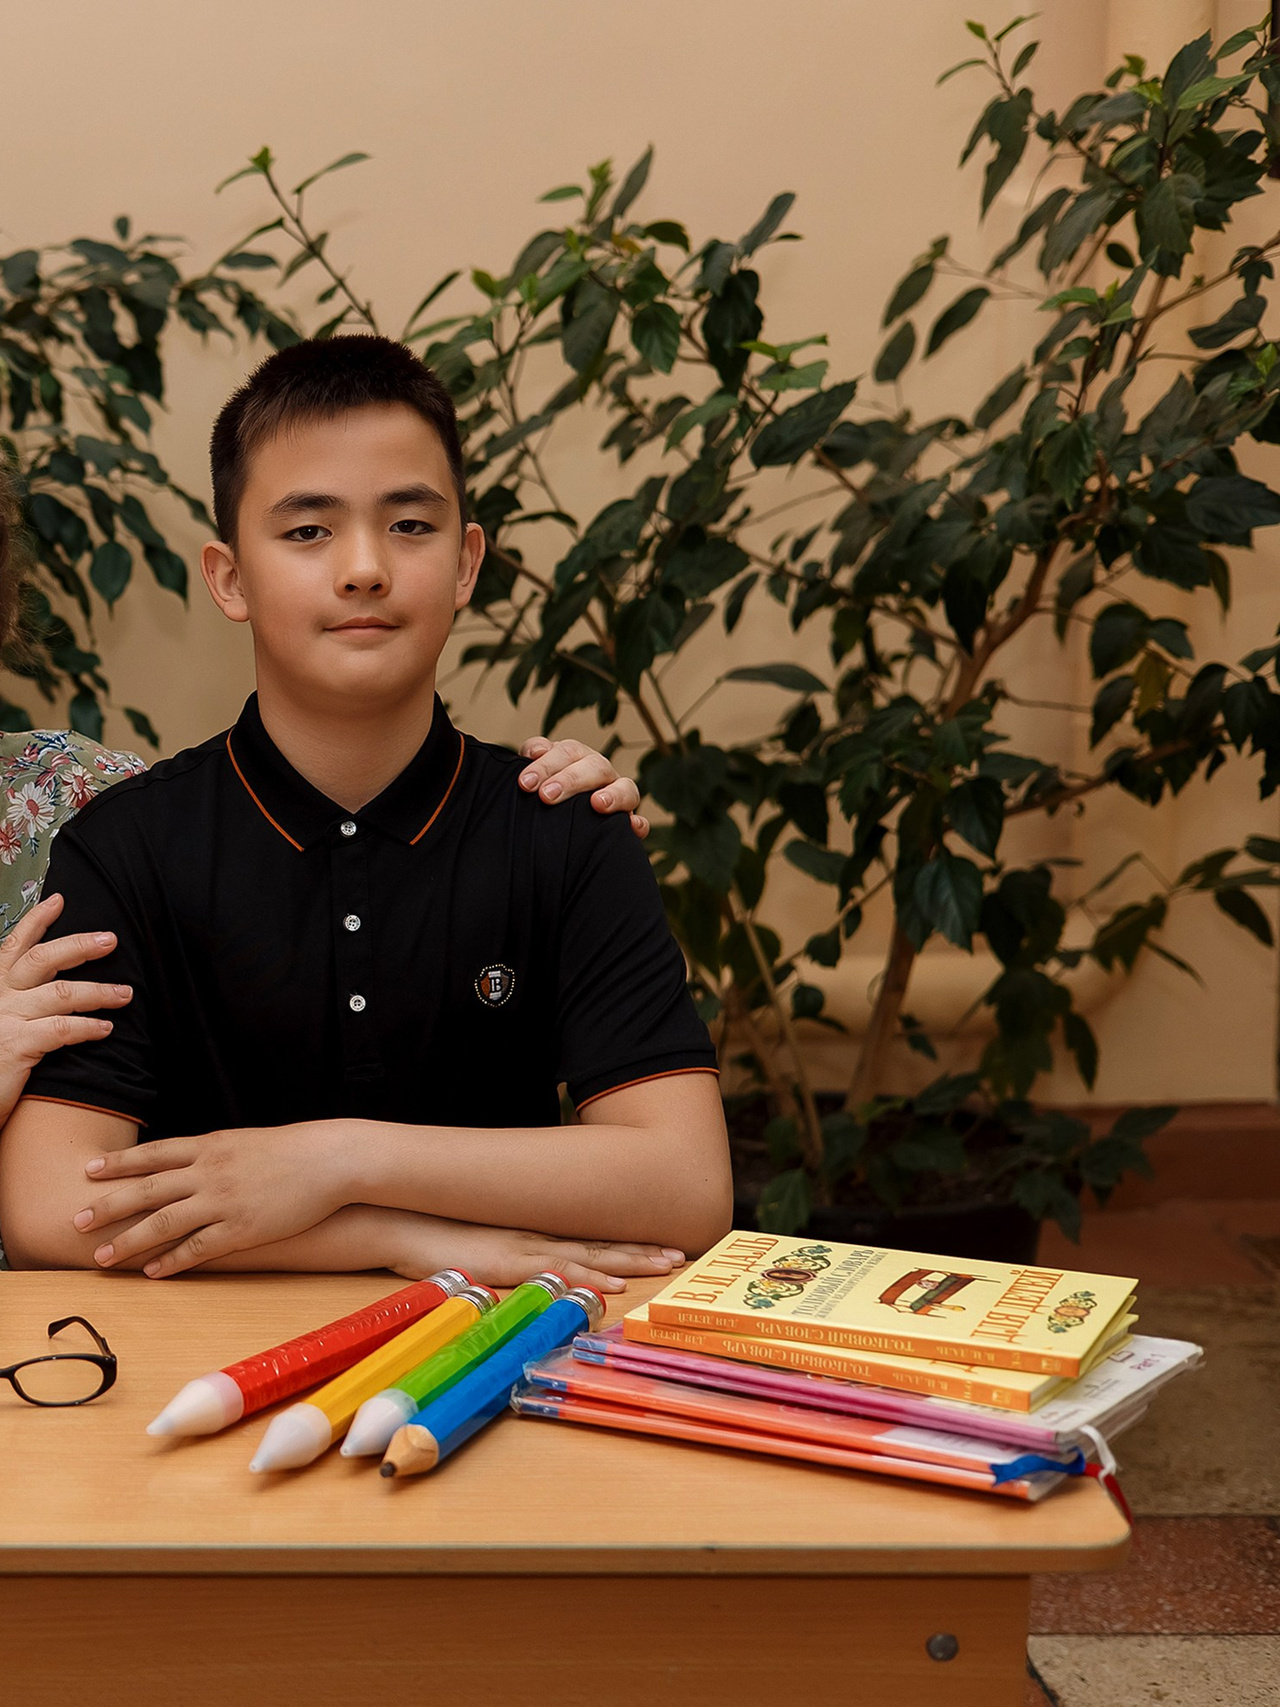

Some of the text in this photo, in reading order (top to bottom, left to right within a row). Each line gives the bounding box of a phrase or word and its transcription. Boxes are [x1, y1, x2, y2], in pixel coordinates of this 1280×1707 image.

[707, 1237, 780, 1274] ДАЛЬ
[791, 1249, 874, 1315] ТОЛКОВЫЙ СЛОВАРЬ
[677, 1312, 739, 1328] ДЛЯ ДЕТЕЙ
[970, 1269, 1063, 1344] ДЛЯ ДЕТЕЙ
[649, 1328, 706, 1345] ДЛЯ ДЕТЕЙ
[756, 1320, 914, 1352] ТОЛКОВЫЙ СЛОВАРЬ
[723, 1339, 871, 1377] ТОЛКОВЫЙ СЛОВАРЬ
